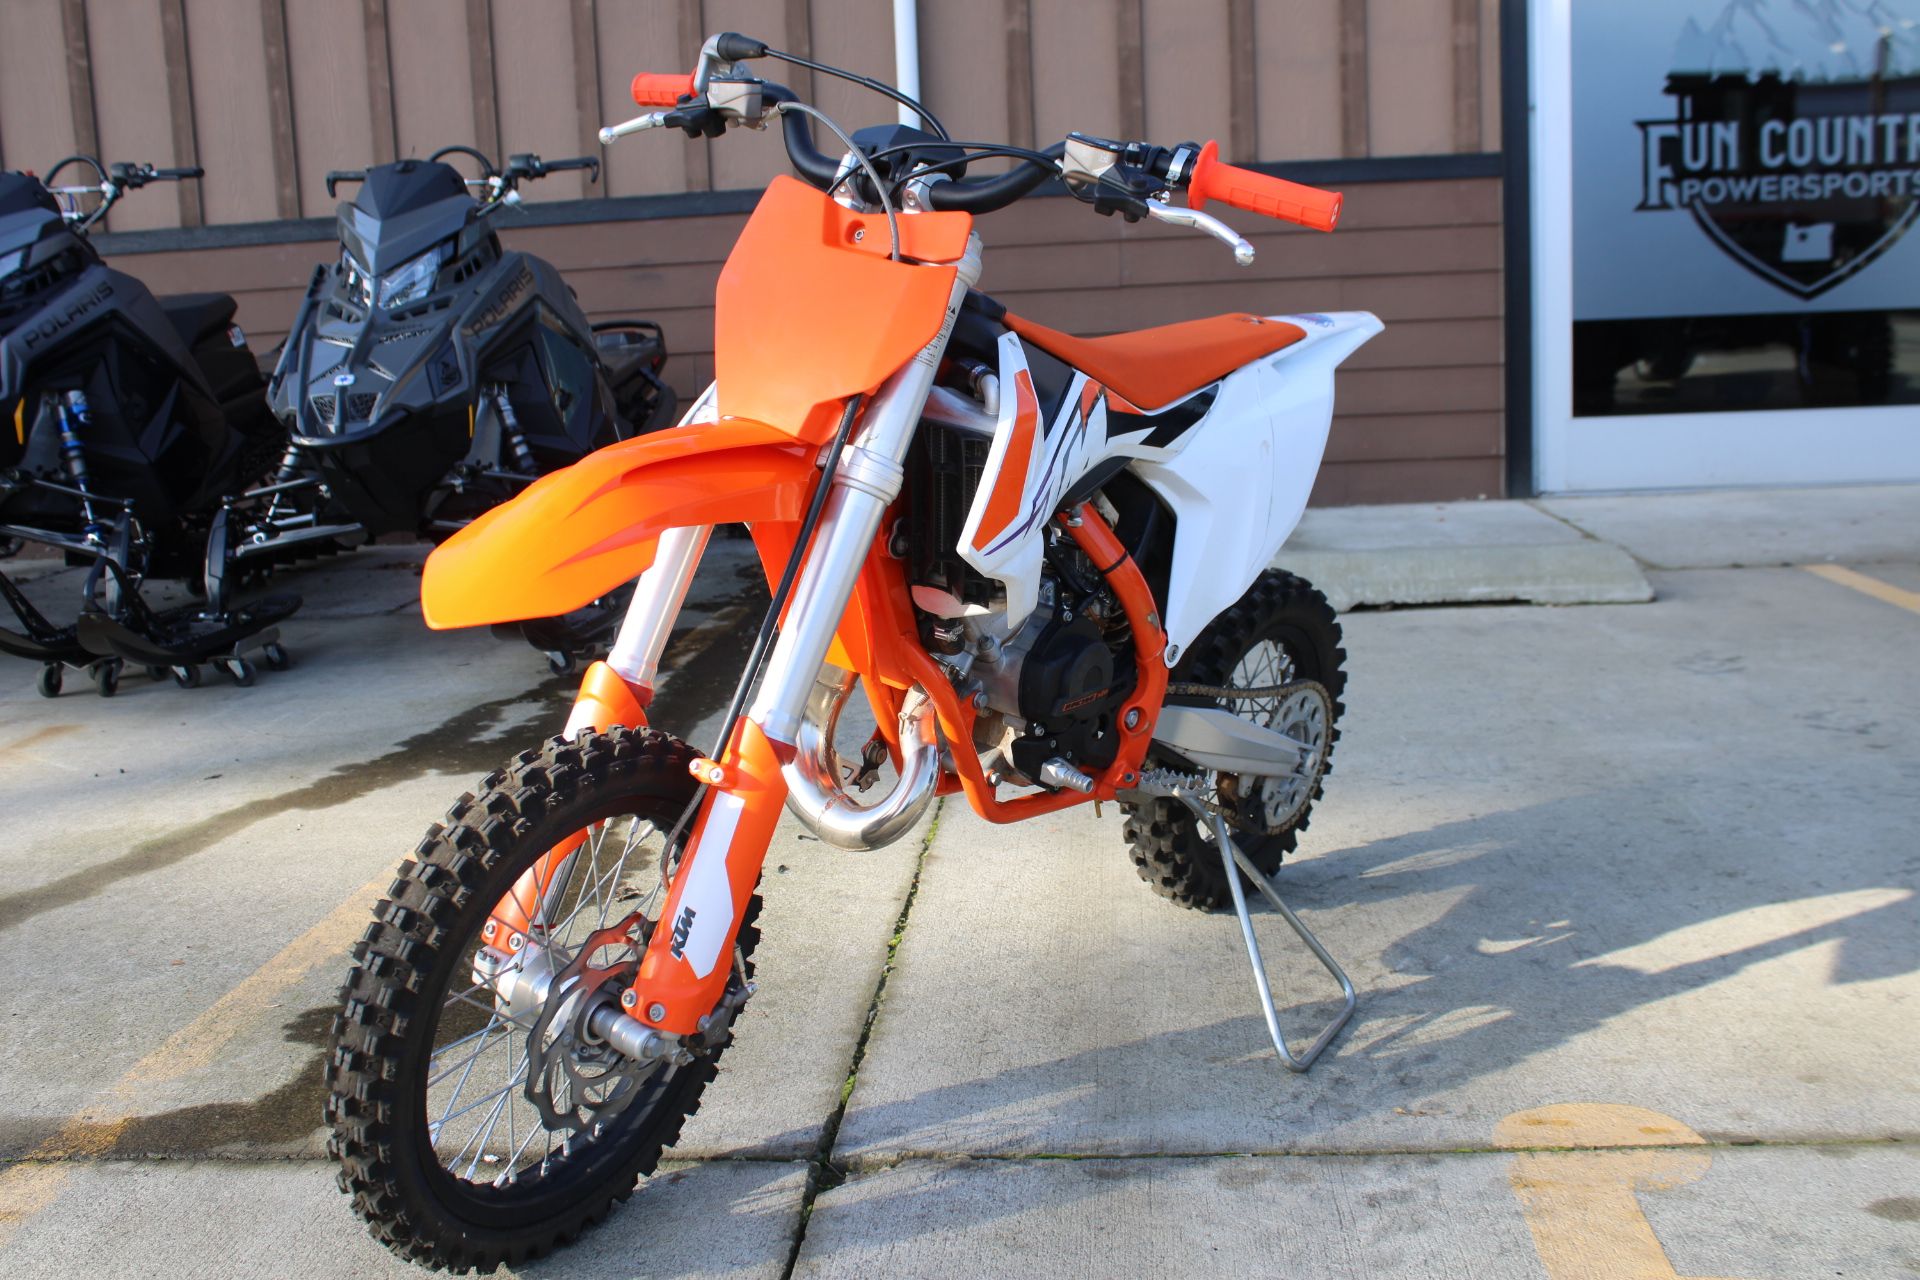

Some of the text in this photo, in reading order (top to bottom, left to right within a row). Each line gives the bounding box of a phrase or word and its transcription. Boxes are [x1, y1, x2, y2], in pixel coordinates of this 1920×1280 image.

[1635, 120, 1740, 211] FUN
[22, 280, 115, 350] POLARIS
[470, 265, 534, 339] POLARIS
[670, 905, 697, 960] KTM
